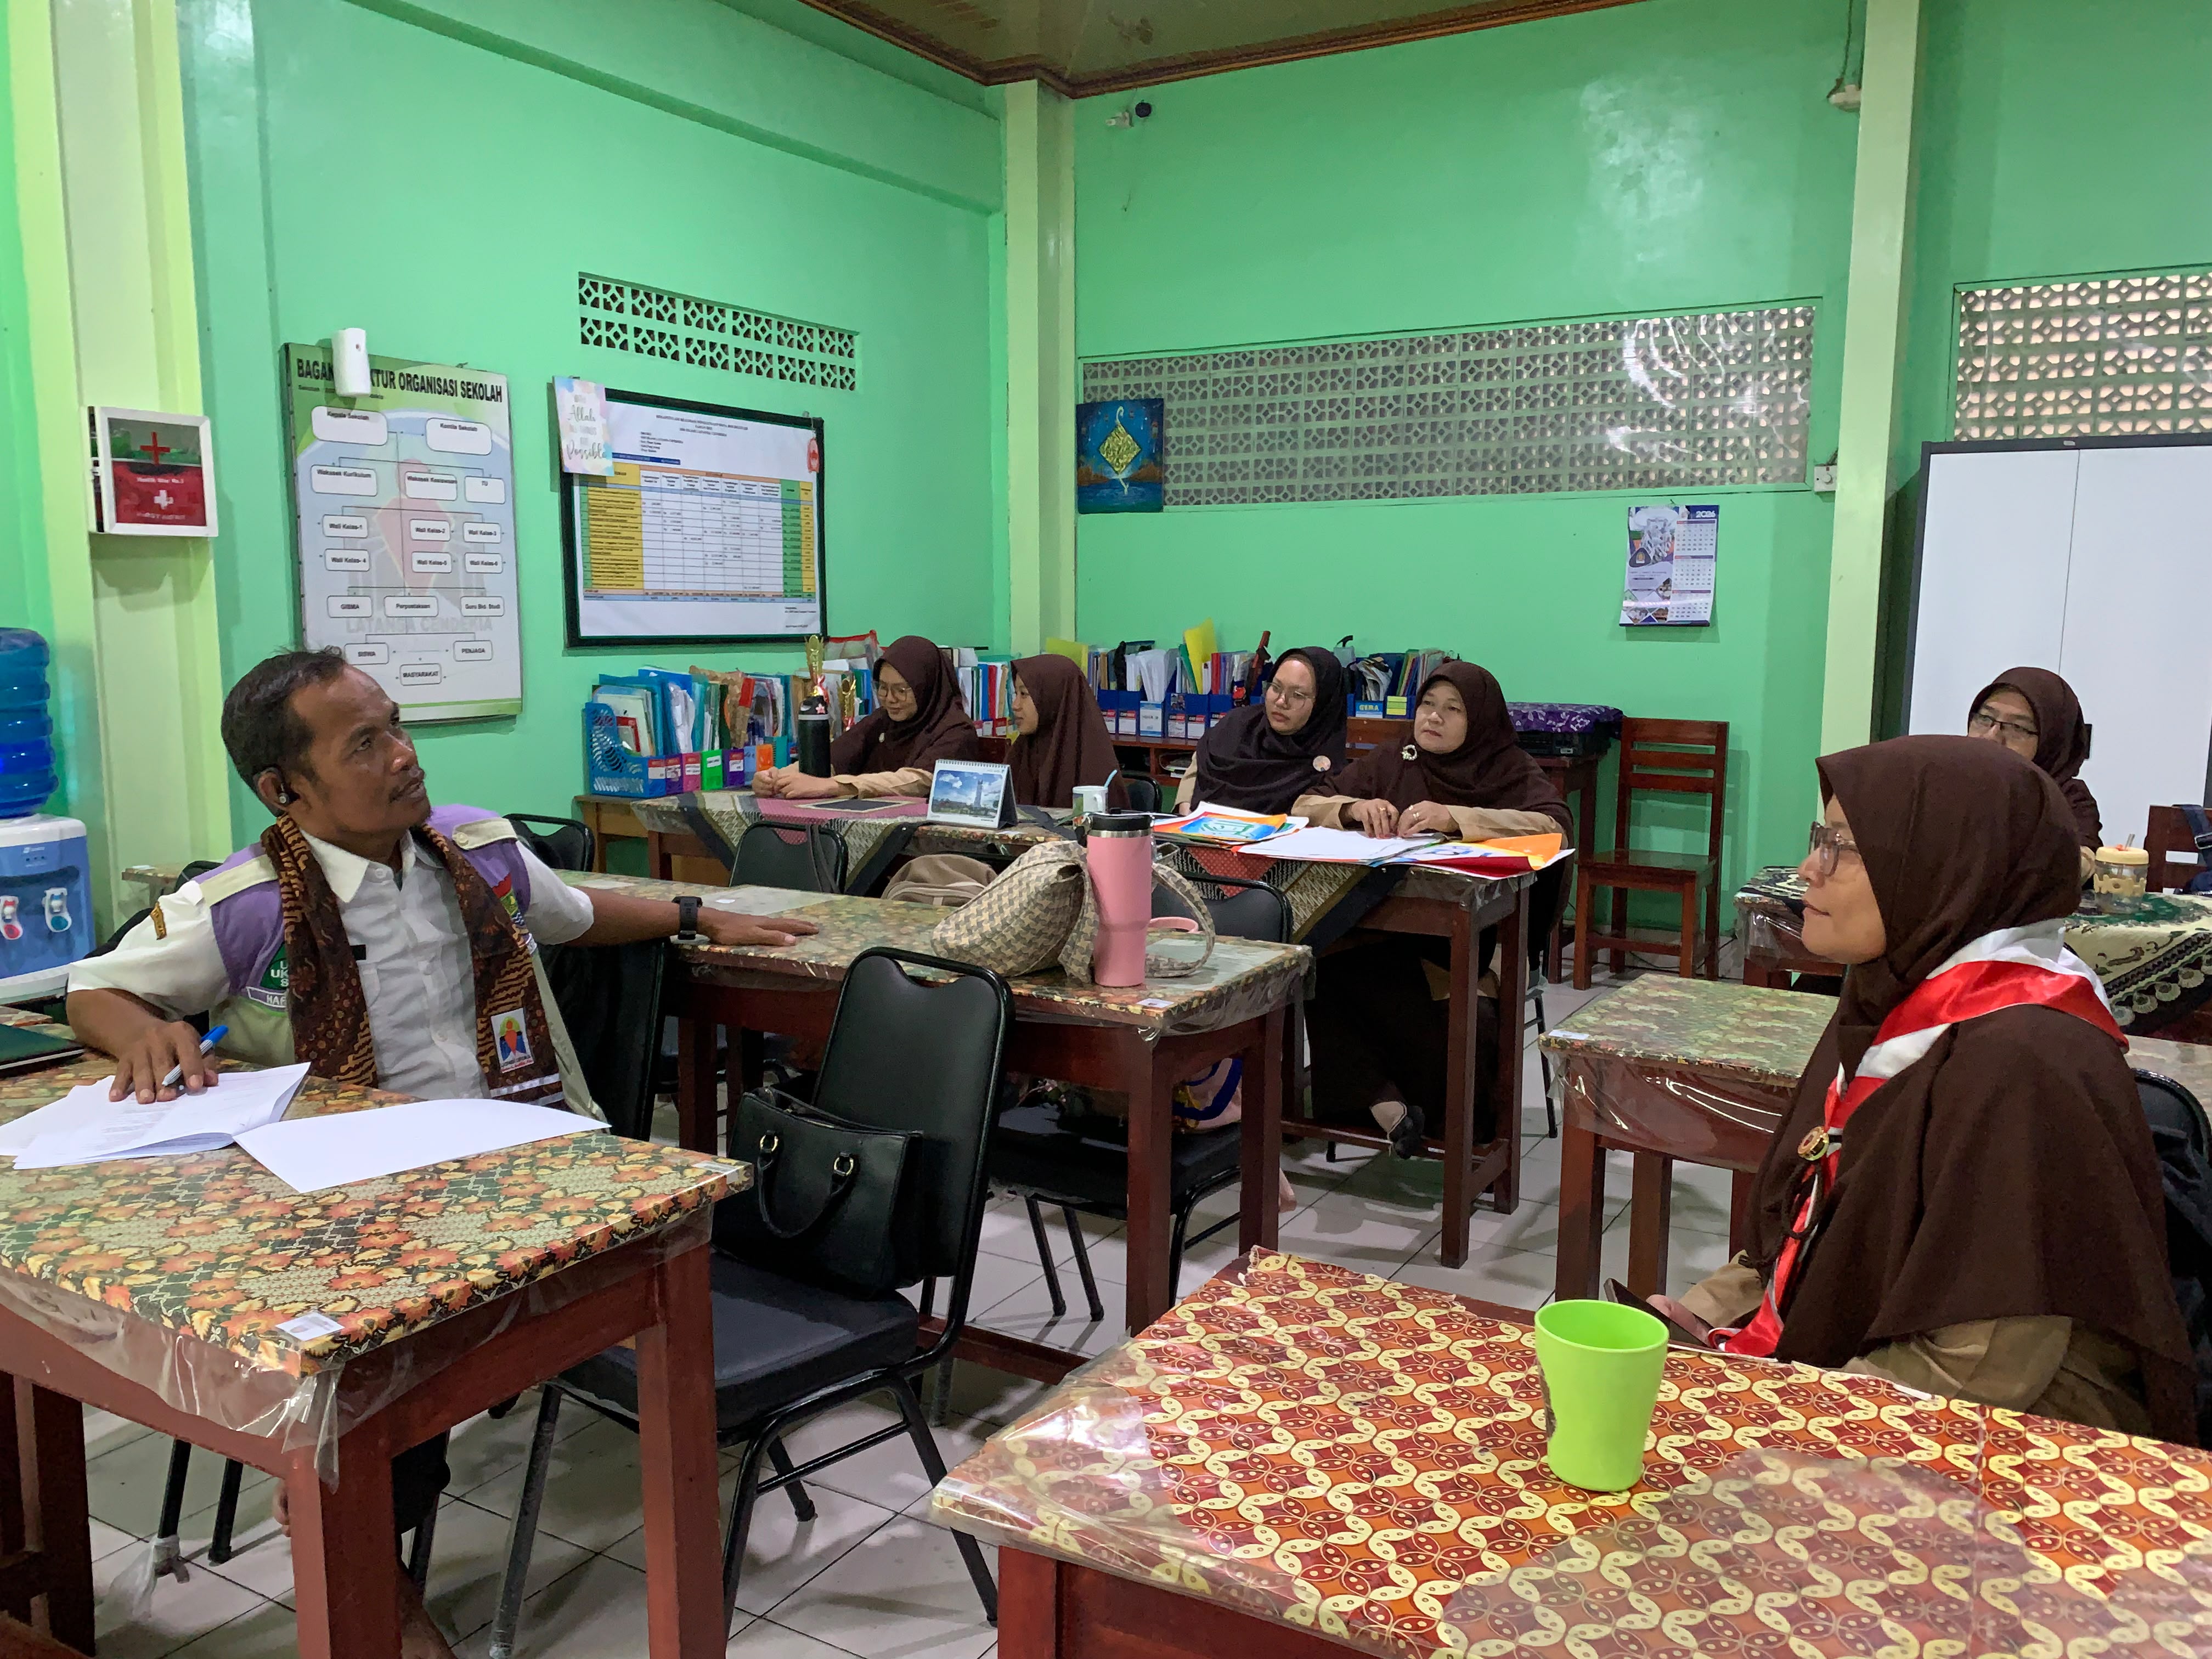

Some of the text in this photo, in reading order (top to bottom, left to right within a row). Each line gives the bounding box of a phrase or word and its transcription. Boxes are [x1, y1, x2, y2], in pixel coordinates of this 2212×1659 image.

[398, 372, 458, 397] ORGANISASI
[460, 380, 502, 403] SEKOLAH
[567, 404, 596, 422] Allah
